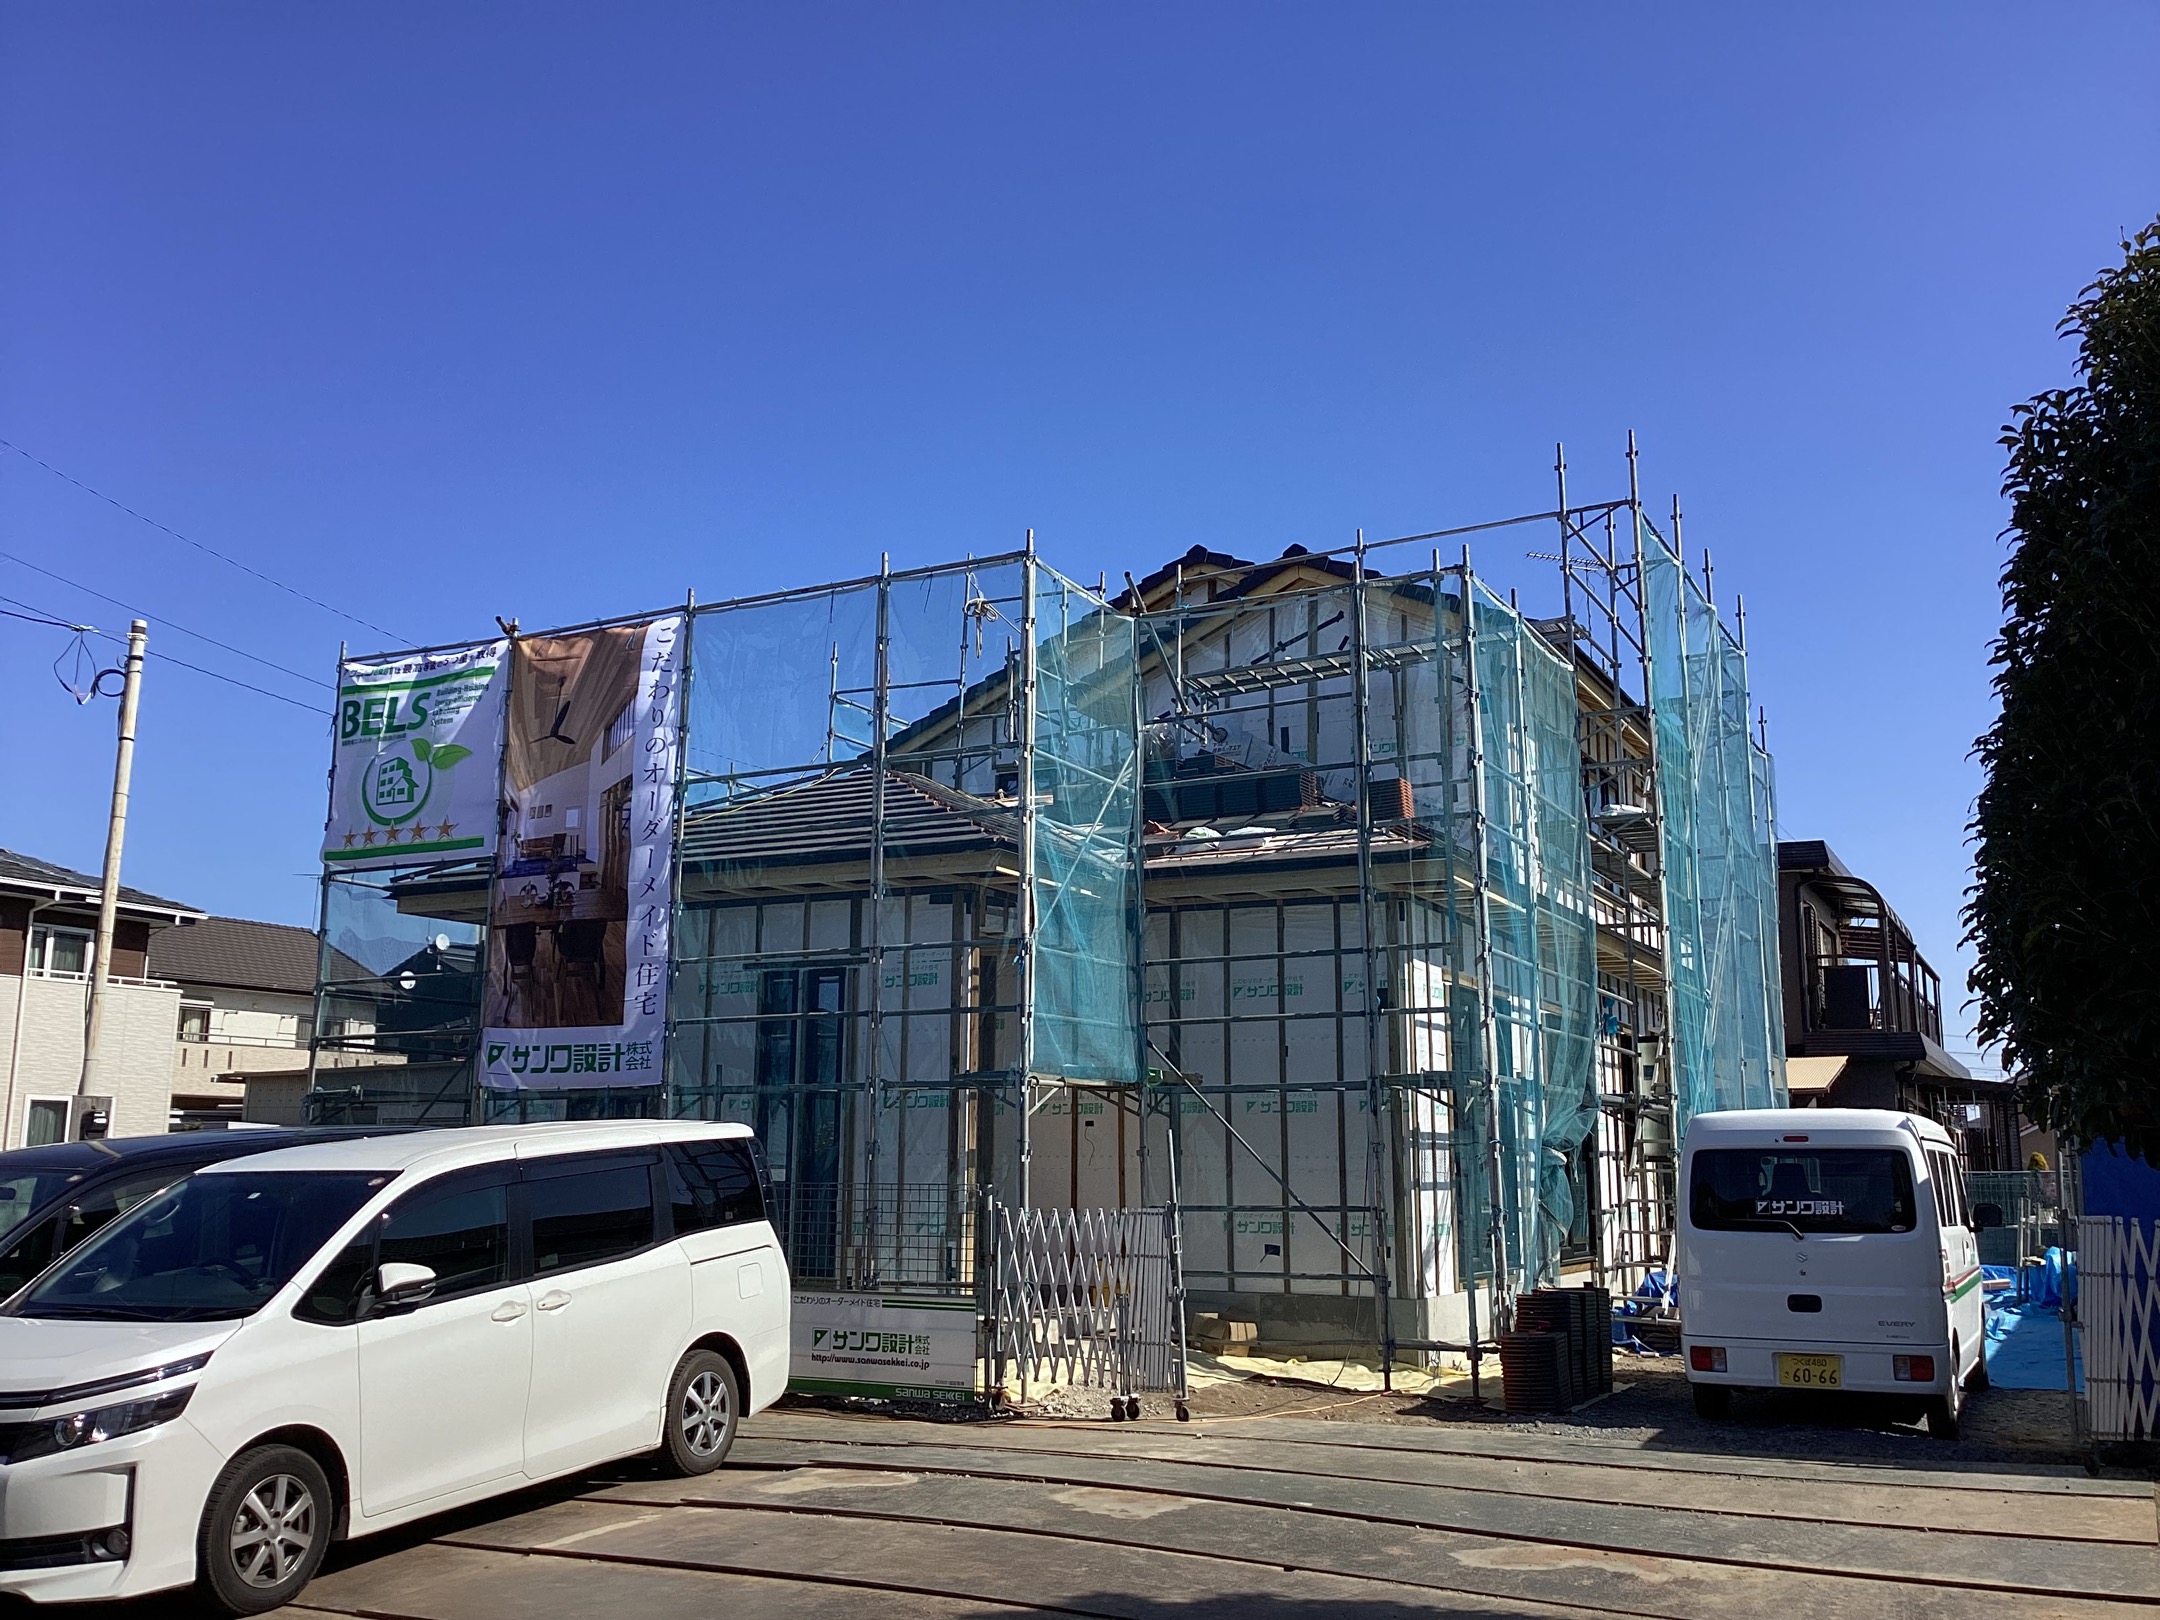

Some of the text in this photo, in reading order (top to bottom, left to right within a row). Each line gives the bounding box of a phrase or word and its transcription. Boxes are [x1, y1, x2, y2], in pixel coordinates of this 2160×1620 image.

[341, 692, 432, 739] BELS
[633, 626, 673, 1016] こだわりのオーダーメイド住宅
[511, 1042, 626, 1074] サンワ設計
[1771, 1200, 1845, 1215] サンワ設計
[793, 1295, 881, 1308] こだわりのオーダーメイド住宅
[1878, 1320, 1916, 1328] EVERY
[832, 1330, 915, 1355] サンワ設計
[811, 1352, 931, 1371] http://www.sanwasekkei.co.jp
[1792, 1368, 1838, 1385] 60-66
